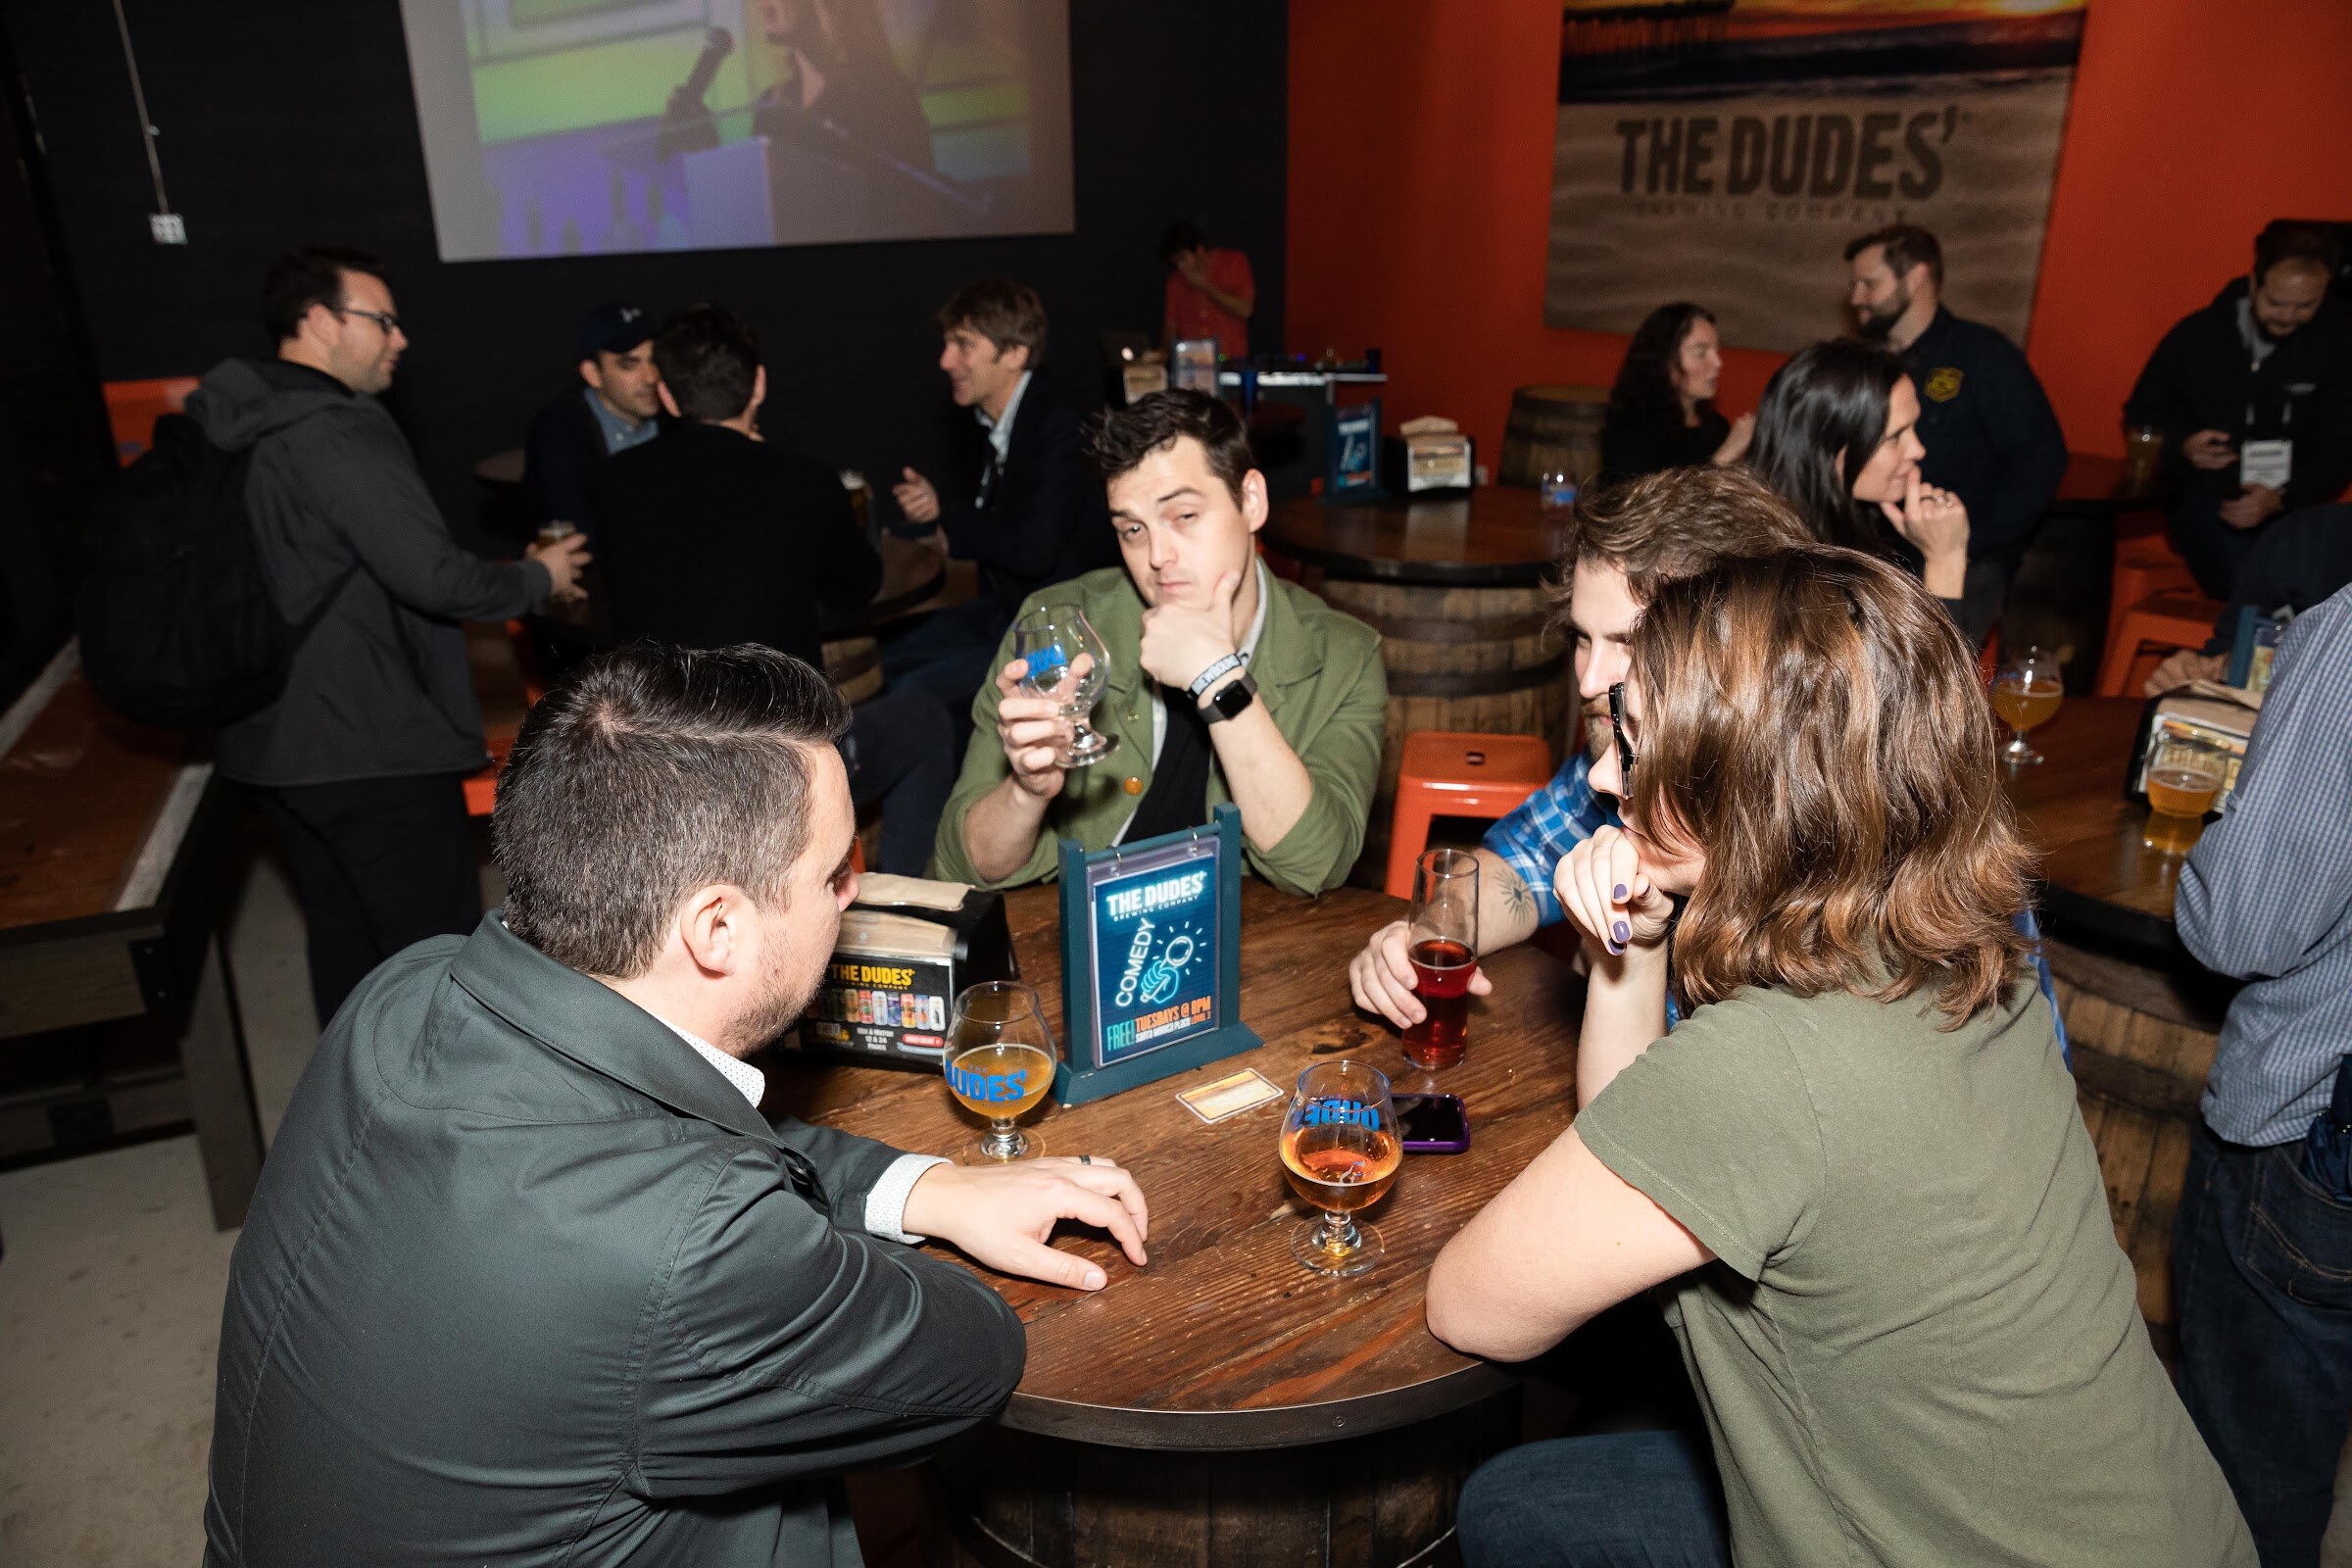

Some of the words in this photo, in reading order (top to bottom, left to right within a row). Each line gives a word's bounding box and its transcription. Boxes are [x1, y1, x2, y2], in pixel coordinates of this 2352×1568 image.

[1615, 116, 1719, 194] THE
[1105, 888, 1143, 917] THE
[1113, 906, 1153, 922] BREWING
[1157, 895, 1199, 910] COMPANY
[830, 964, 859, 981] THE
[1115, 917, 1155, 1007] COMEDY
[1135, 1004, 1180, 1033] TUESDAYS
[1180, 1002, 1190, 1018] @
[1106, 1019, 1136, 1052] FREE!
